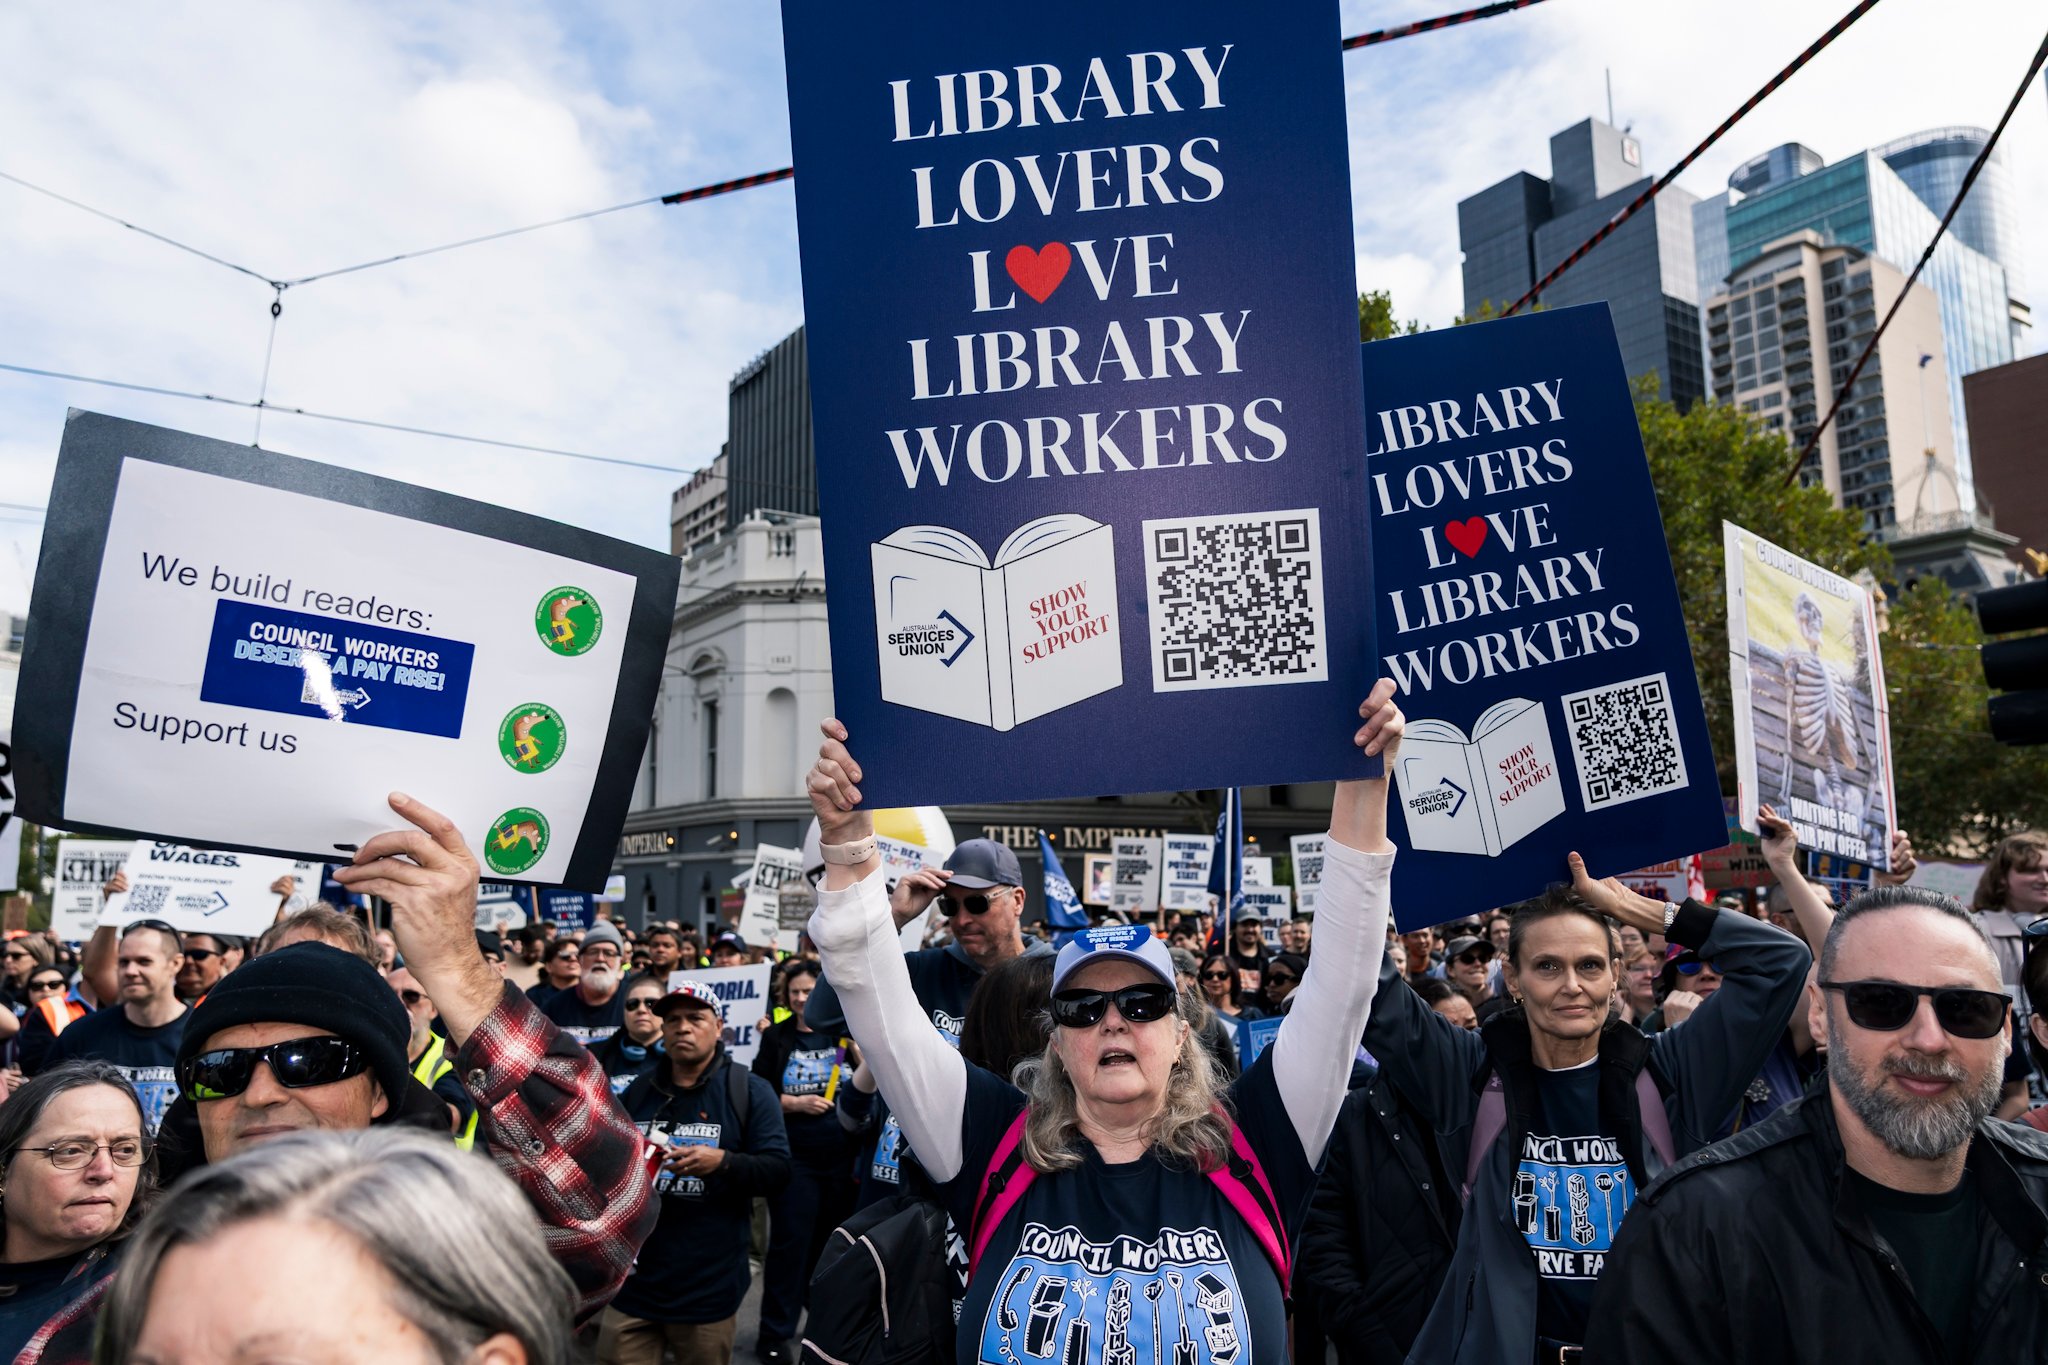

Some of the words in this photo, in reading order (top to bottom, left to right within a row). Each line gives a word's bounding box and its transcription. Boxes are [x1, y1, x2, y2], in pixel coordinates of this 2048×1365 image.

[888, 44, 1234, 142] LIBRARY
[912, 136, 1225, 229] LOVERS
[968, 232, 1179, 313] LVE
[907, 309, 1252, 400] LIBRARY
[884, 397, 1288, 489] WORKERS
[1372, 438, 1573, 516] LOVERS
[1419, 502, 1558, 570] LVE
[142, 552, 198, 586] We
[210, 565, 292, 604] build
[302, 588, 433, 632] readers:
[1029, 580, 1087, 619] SHOW
[1388, 547, 1606, 635] LIBRARY
[902, 624, 939, 632] AUSTRALIAN
[1036, 602, 1090, 637] YOUR
[249, 621, 339, 653] COUNCIL
[344, 637, 440, 670] WORKERS
[888, 629, 955, 645] SERVICES
[899, 642, 945, 657] UNION
[1022, 614, 1110, 664] SUPPORT
[1383, 603, 1640, 697] WORKERS
[233, 639, 330, 671] DESER
[333, 656, 348, 676] A
[352, 658, 392, 682] PAY
[394, 665, 446, 692] RISE!
[113, 702, 249, 747] Support
[259, 730, 298, 754] us
[1499, 742, 1534, 775] SHOW
[1504, 757, 1538, 786] YOUR
[1409, 790, 1454, 809] SERVICES
[1417, 788, 1442, 798] AUSTRALIAN
[1499, 763, 1552, 807] SUPPORT
[1417, 800, 1449, 816] UNION
[1790, 796, 1837, 829] WAITING
[1838, 810, 1859, 836] FOR
[622, 831, 669, 856] IMPERIAL
[983, 825, 1038, 848] THE
[1167, 841, 1209, 851] VICTORIA.
[1816, 828, 1837, 853] PAY
[1837, 834, 1868, 861] OFFER
[150, 849, 241, 868] WAGES.
[1181, 851, 1195, 860] THE
[1176, 871, 1198, 880] STATE
[1086, 931, 1128, 939] DESERVE
[935, 1013, 964, 1035] COUN
[1573, 1139, 1624, 1163] WORK
[873, 1164, 899, 1182] DESE
[1596, 1177, 1613, 1187] STOP
[1021, 1228, 1113, 1273] COUNCIL
[1122, 1233, 1222, 1270] WORKERS
